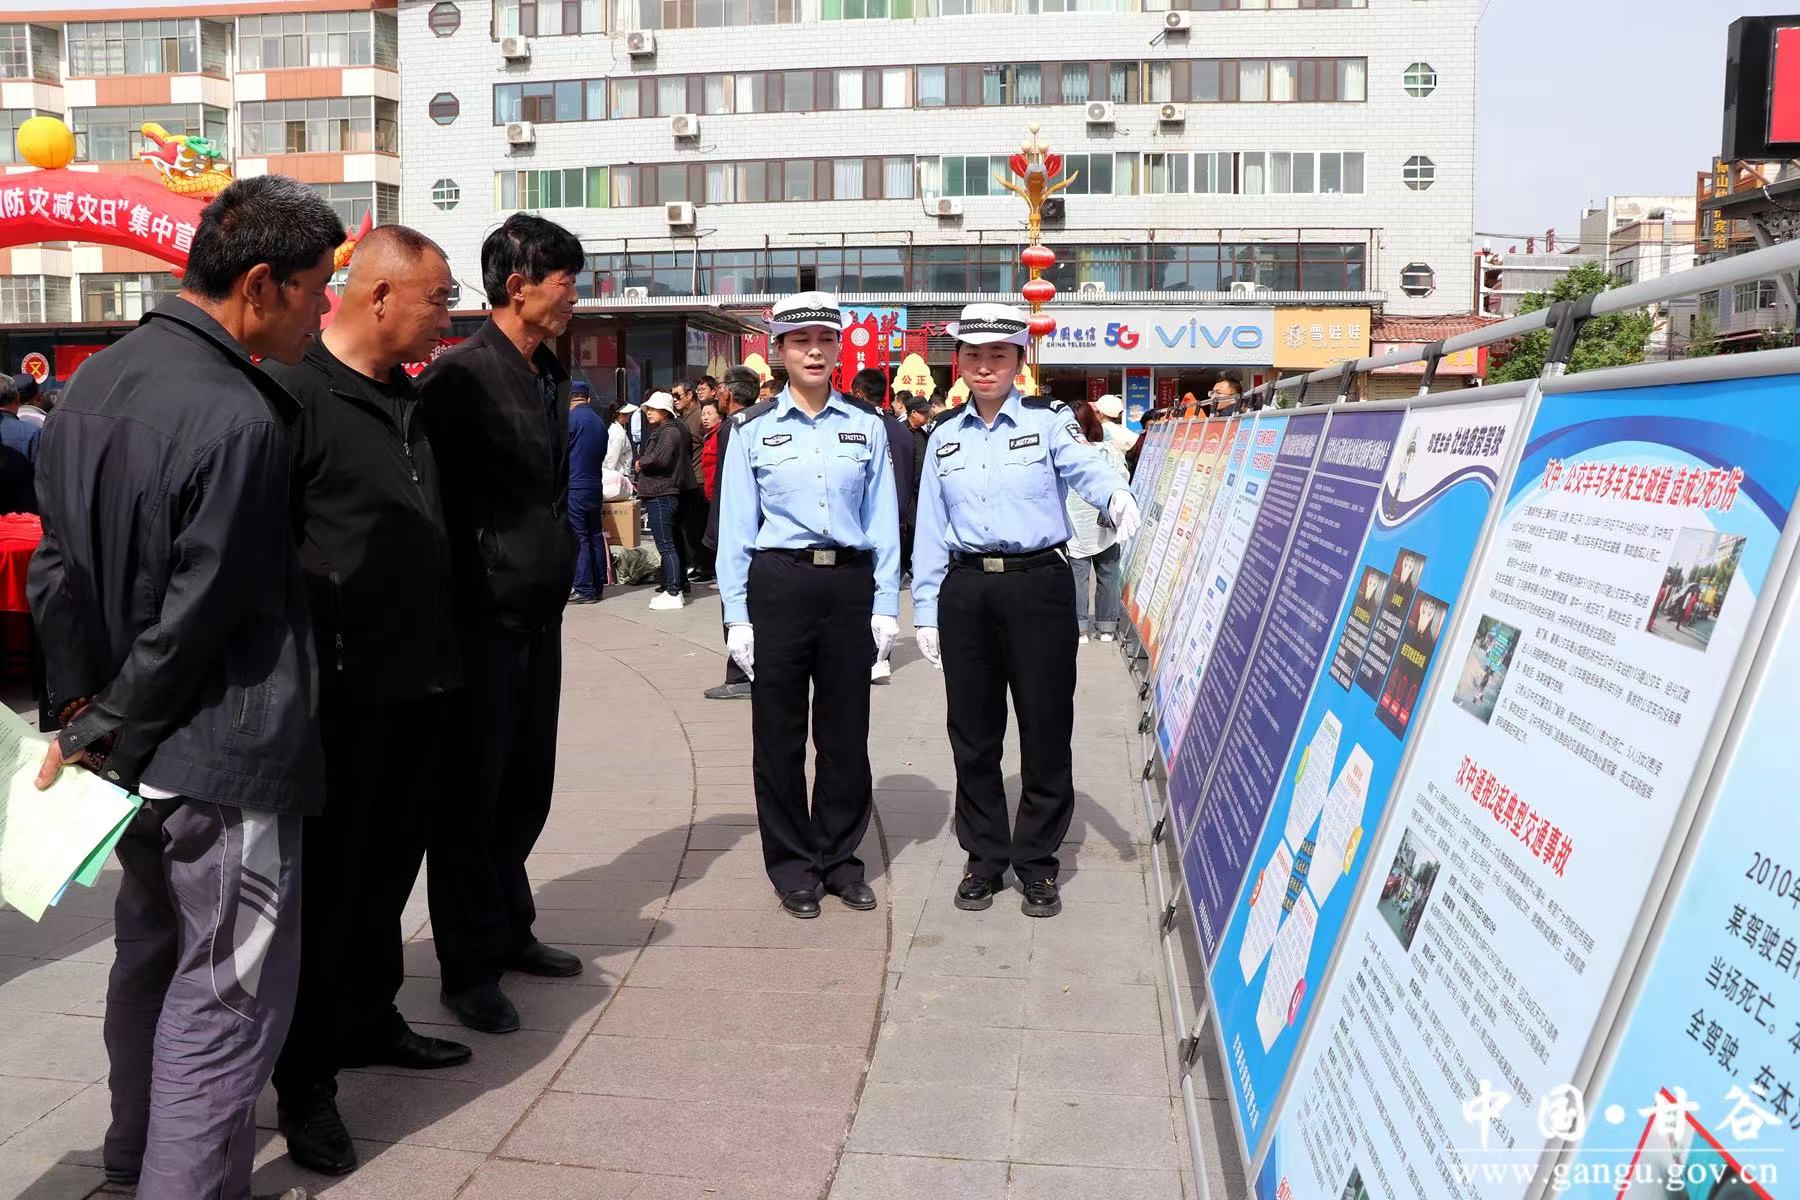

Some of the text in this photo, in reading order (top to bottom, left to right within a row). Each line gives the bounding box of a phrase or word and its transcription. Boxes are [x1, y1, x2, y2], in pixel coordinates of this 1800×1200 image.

[1104, 322, 1140, 349] 5G
[1155, 317, 1263, 350] vivo
[1311, 323, 1360, 341] 雪娃娃
[902, 375, 926, 385] 公正
[1450, 425, 1506, 457] 杜绝疲劳驾驶
[1455, 754, 1573, 879] 汉中通报2起典型交通事故
